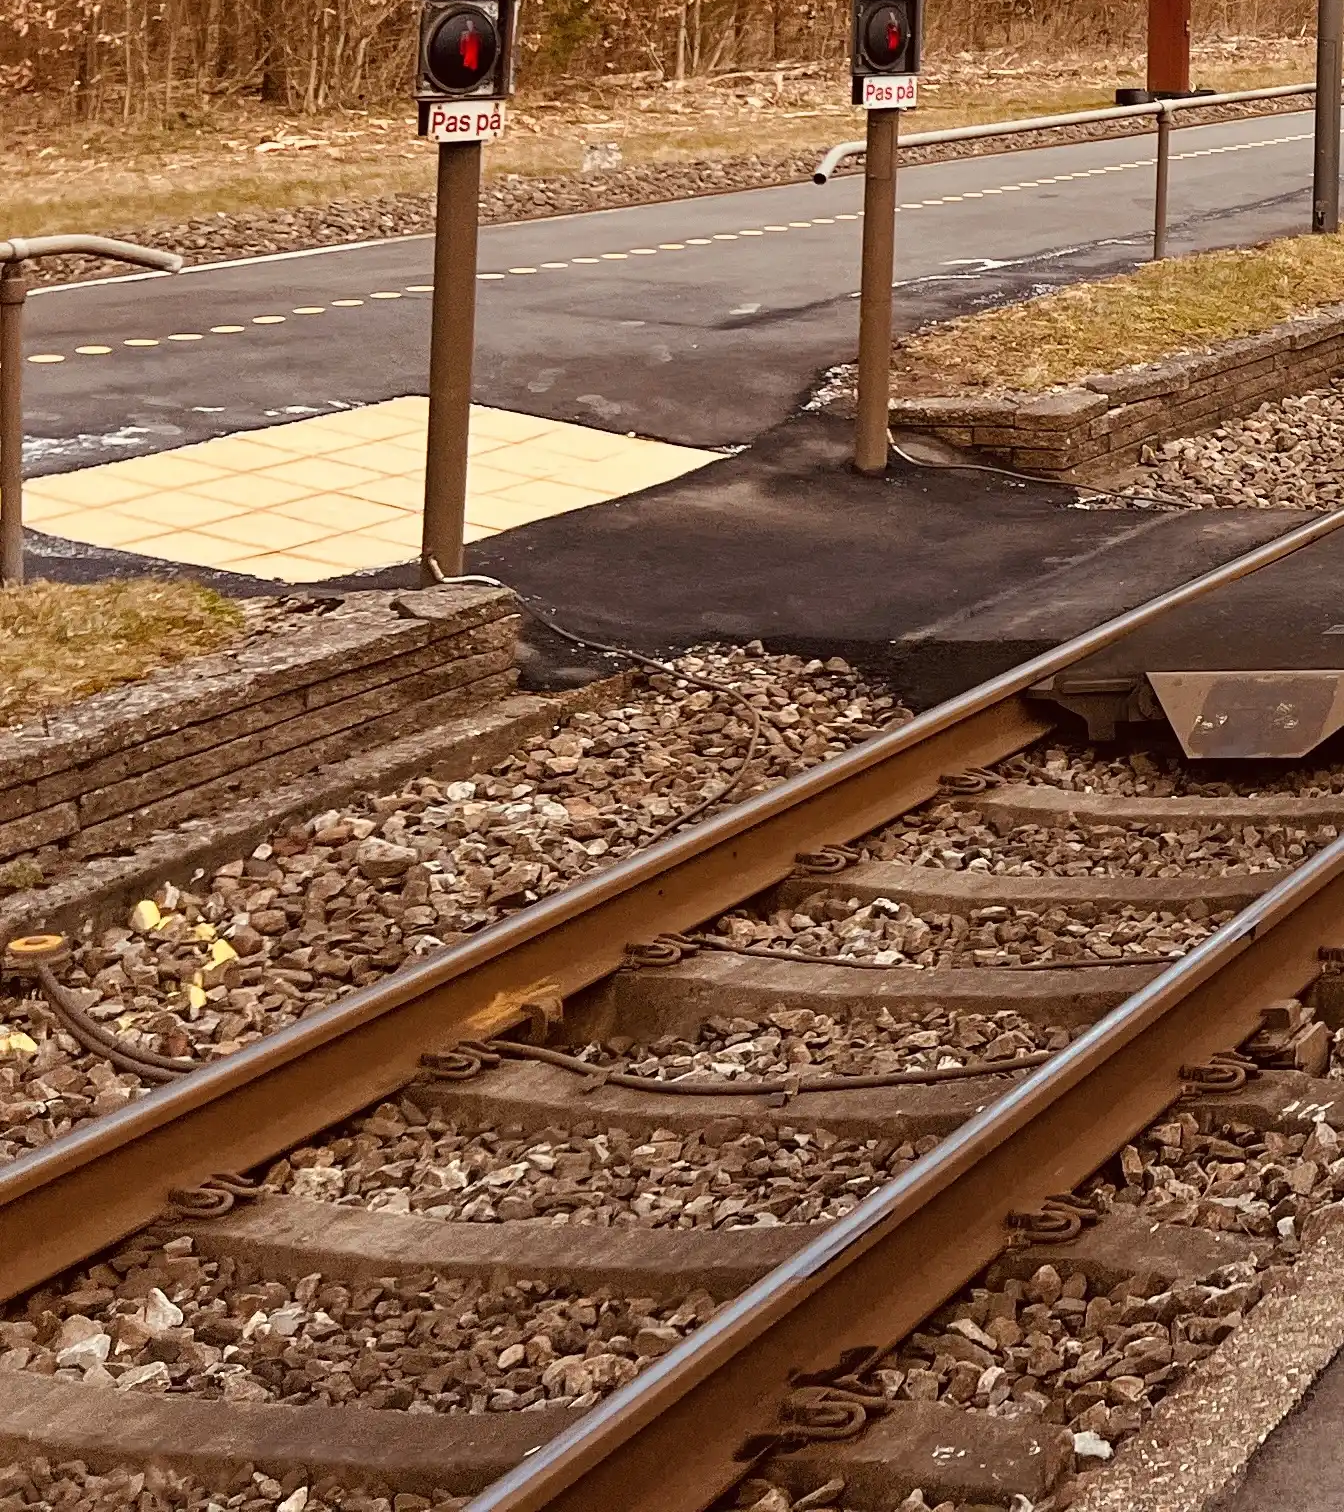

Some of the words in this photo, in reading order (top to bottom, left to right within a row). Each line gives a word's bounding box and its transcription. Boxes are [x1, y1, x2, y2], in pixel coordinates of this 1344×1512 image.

[866, 84, 893, 102] Pas
[896, 81, 914, 104] på
[431, 111, 471, 134] Pas
[475, 106, 501, 136] på
